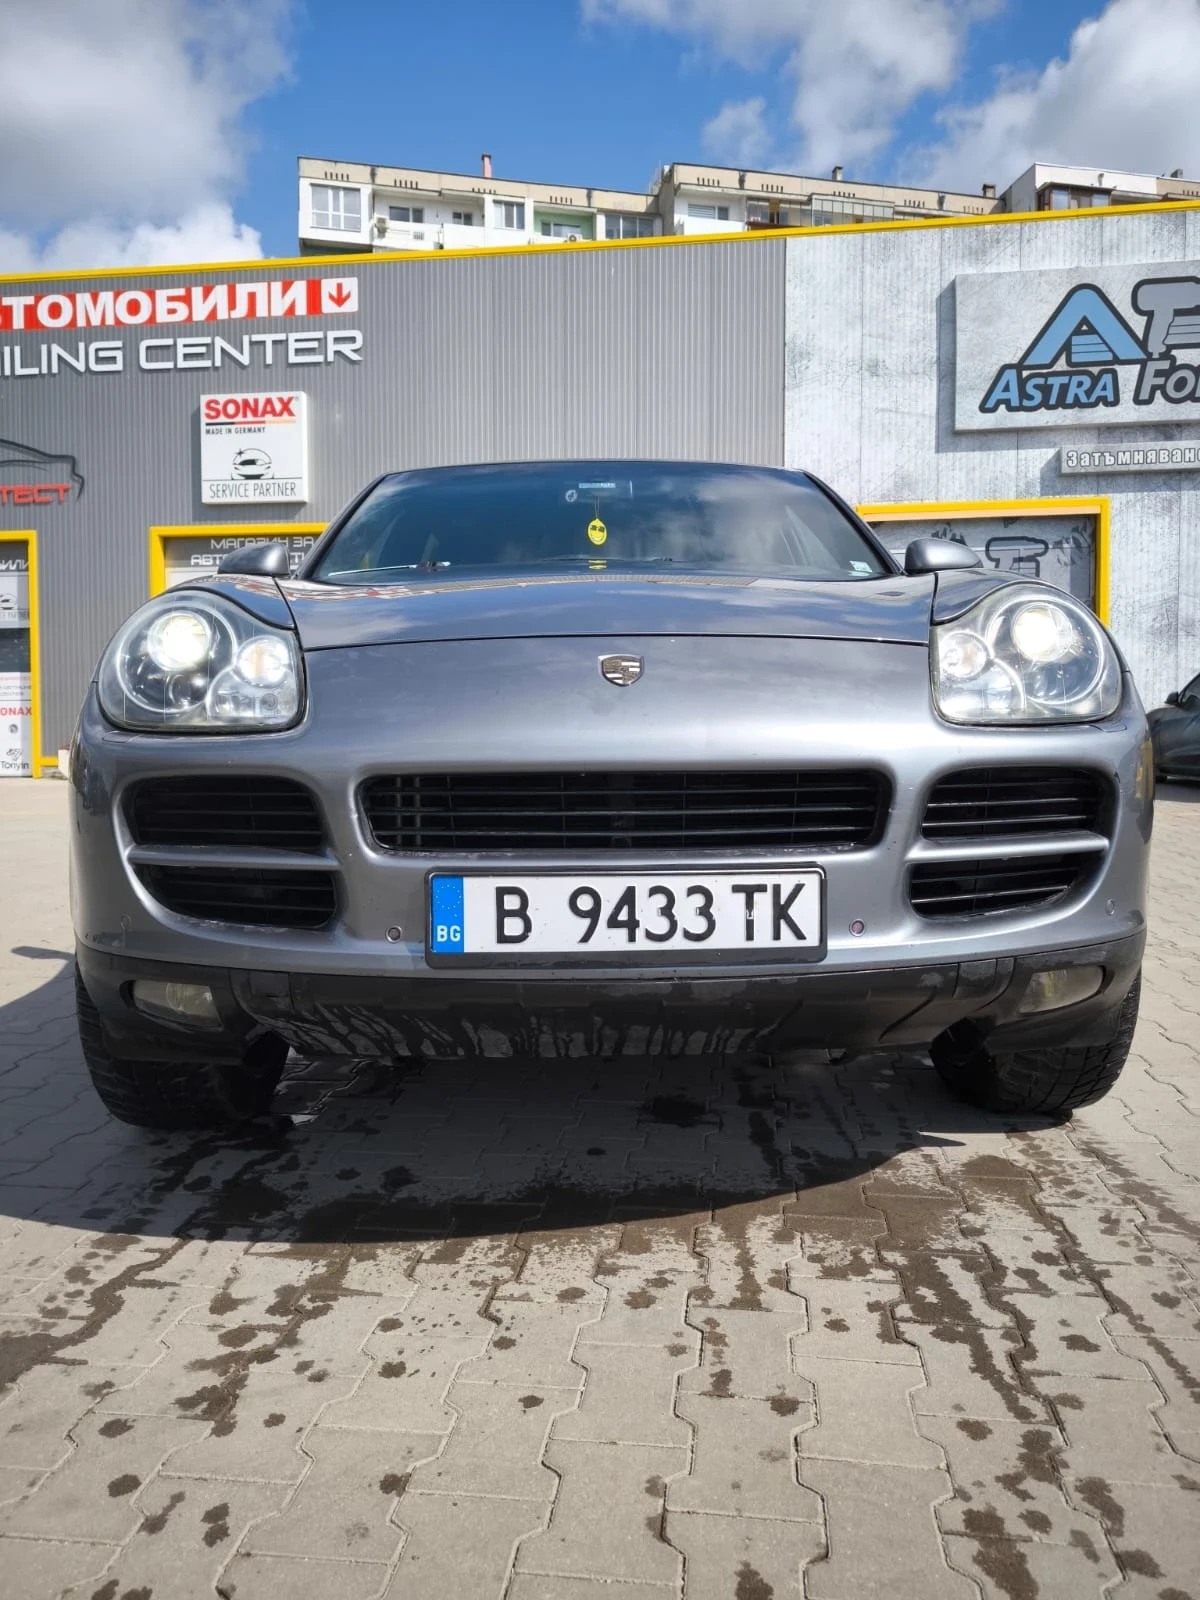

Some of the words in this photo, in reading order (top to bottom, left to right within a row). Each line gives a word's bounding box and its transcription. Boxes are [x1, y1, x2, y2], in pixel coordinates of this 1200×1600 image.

[0, 279, 307, 330] ТОМОБИЛИ
[0, 341, 123, 376] ILING
[139, 330, 363, 369] CENTER
[982, 367, 1117, 410] ASTRA
[1136, 359, 1200, 403] FO
[204, 396, 296, 420] SONAX
[209, 483, 249, 498] SERVICE
[253, 481, 297, 497] PARTNER
[436, 925, 461, 942] BG
[495, 886, 533, 944] B
[568, 883, 717, 943] 9433
[731, 883, 806, 942] TK
